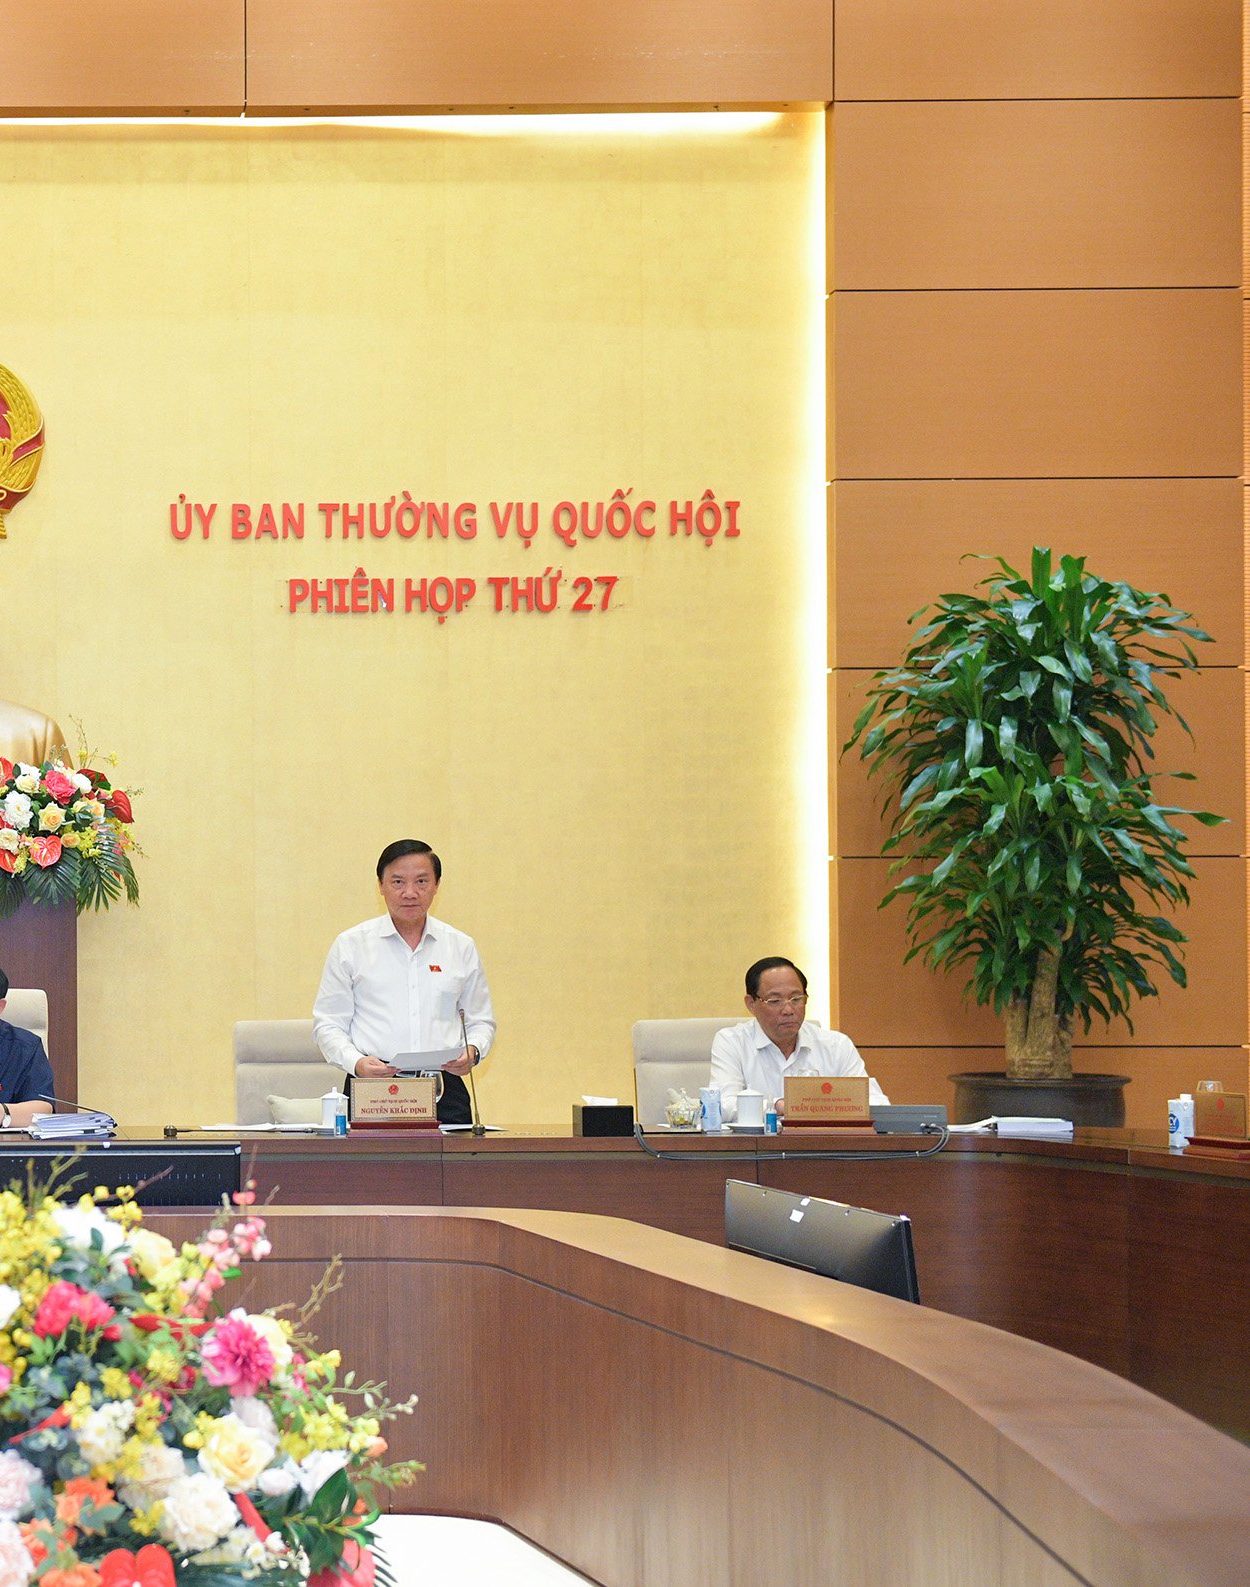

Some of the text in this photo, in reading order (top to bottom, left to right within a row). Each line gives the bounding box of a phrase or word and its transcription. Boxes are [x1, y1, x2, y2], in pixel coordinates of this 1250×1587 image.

[170, 488, 741, 548] ỦY BAN THƯỜNG VỤ QUỐC HỘI
[289, 566, 619, 624] PHIÊN HỌP THỨ 27
